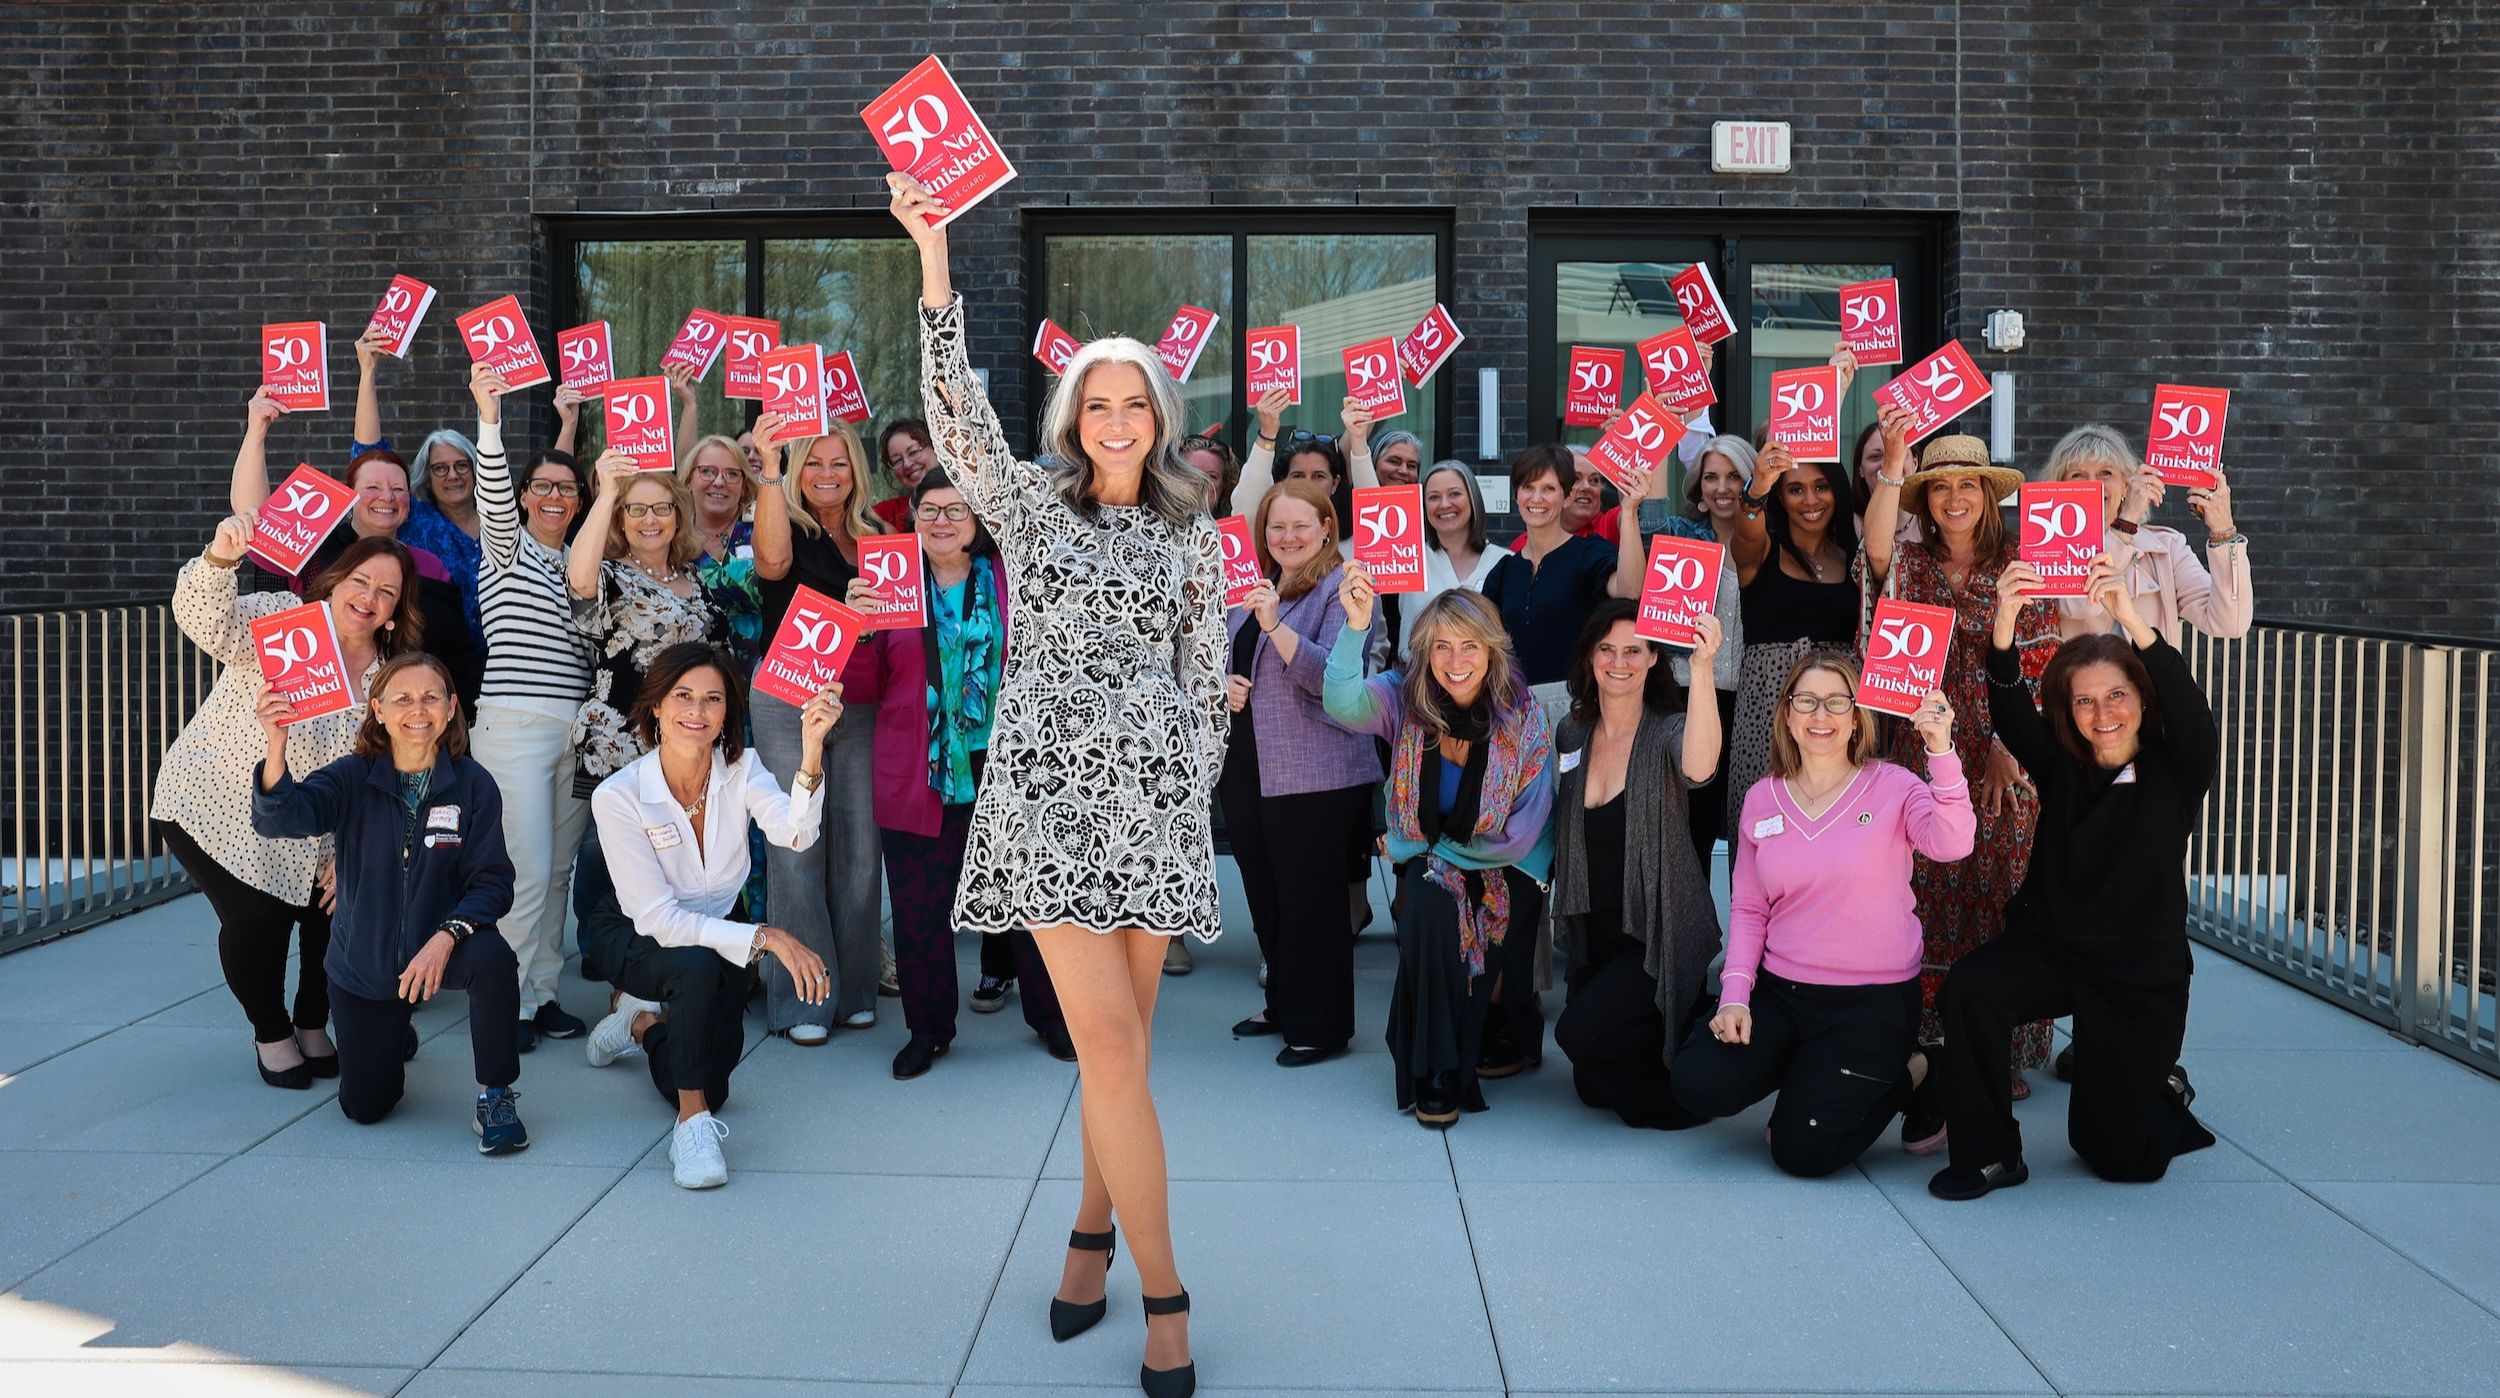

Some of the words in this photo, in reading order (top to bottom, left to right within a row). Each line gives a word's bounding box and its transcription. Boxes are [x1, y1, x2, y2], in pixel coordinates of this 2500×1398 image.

[882, 94, 949, 173] 50
[941, 123, 981, 158] Not
[1730, 126, 1779, 164] EXIT
[921, 140, 992, 195] inished
[962, 172, 987, 193] CIARDI
[377, 285, 411, 312] 50
[1677, 283, 1703, 320] 50
[1700, 304, 1717, 318] Not
[1845, 294, 1886, 332] 50
[387, 315, 406, 331] Not
[676, 319, 715, 342] 50
[1162, 316, 1198, 342] 50
[1412, 316, 1442, 350] 50
[1692, 313, 1723, 336] inished
[1873, 324, 1896, 337] Not
[468, 316, 515, 360] 50
[730, 328, 771, 361] 50
[1849, 337, 1896, 351] inished
[267, 336, 310, 374] 50
[507, 341, 534, 358] Not
[564, 337, 598, 373] 50
[669, 349, 706, 367] Finished
[691, 344, 709, 358] Not
[1159, 350, 1186, 367] nished
[1174, 344, 1191, 358] Not
[1250, 338, 1287, 373] 50
[492, 352, 538, 375] nished
[588, 361, 608, 374] Not
[1275, 367, 1295, 379] Not
[1350, 354, 1387, 391] 50
[1647, 345, 1689, 387] 50
[296, 368, 320, 381] Not
[730, 372, 761, 384] Finis
[766, 362, 807, 402] 50
[1571, 359, 1613, 393] 50
[1681, 369, 1704, 386] Not
[1909, 355, 1964, 402] 50
[271, 381, 320, 394] inished
[841, 390, 860, 402] Not
[1377, 378, 1398, 394] Not
[795, 394, 817, 408] Not
[828, 399, 863, 417] inished
[1360, 388, 1399, 407] inished
[1597, 391, 1617, 404] Not
[1775, 381, 1824, 422] 50
[610, 392, 655, 433] 50
[783, 407, 817, 423] ished
[1808, 415, 1834, 428] Not
[1918, 398, 1941, 425] Not
[2153, 400, 2210, 441] 50
[641, 426, 666, 440] Not
[1614, 408, 1665, 450] 50
[1774, 428, 1833, 442] Finished
[1599, 441, 1631, 469] Finish
[1630, 449, 1653, 470] Not
[2187, 441, 2216, 457] Not
[268, 480, 330, 520] 50
[1495, 500, 1508, 511] 132
[290, 520, 318, 544] Not
[1357, 502, 1408, 548] 50
[2025, 498, 2087, 547] 50
[1219, 530, 1241, 560] 0
[1391, 543, 1419, 558] Not
[2066, 544, 2098, 559] Not
[864, 548, 908, 590] 50
[1232, 560, 1257, 574] Not
[1647, 551, 1704, 592] 50
[2029, 559, 2090, 576] inishe
[894, 585, 918, 598] Not
[1226, 572, 1259, 590] ished
[877, 598, 919, 613] ished
[1681, 595, 1710, 613] Not
[1642, 605, 1698, 627] Finishe
[779, 608, 842, 655] 50
[1652, 625, 1669, 633] JULIE
[1670, 629, 1692, 638] CIARDI
[1870, 616, 1933, 660] 50
[263, 627, 318, 680] 50
[306, 661, 338, 681] Not
[767, 658, 824, 694] Finishe
[808, 657, 837, 682] Not
[1906, 662, 1937, 683] Not
[281, 675, 342, 703] inished
[773, 683, 788, 695] JULIE
[790, 691, 809, 702] CIARD
[1874, 695, 1892, 704] JULIE
[1894, 699, 1917, 708] CIARDI
